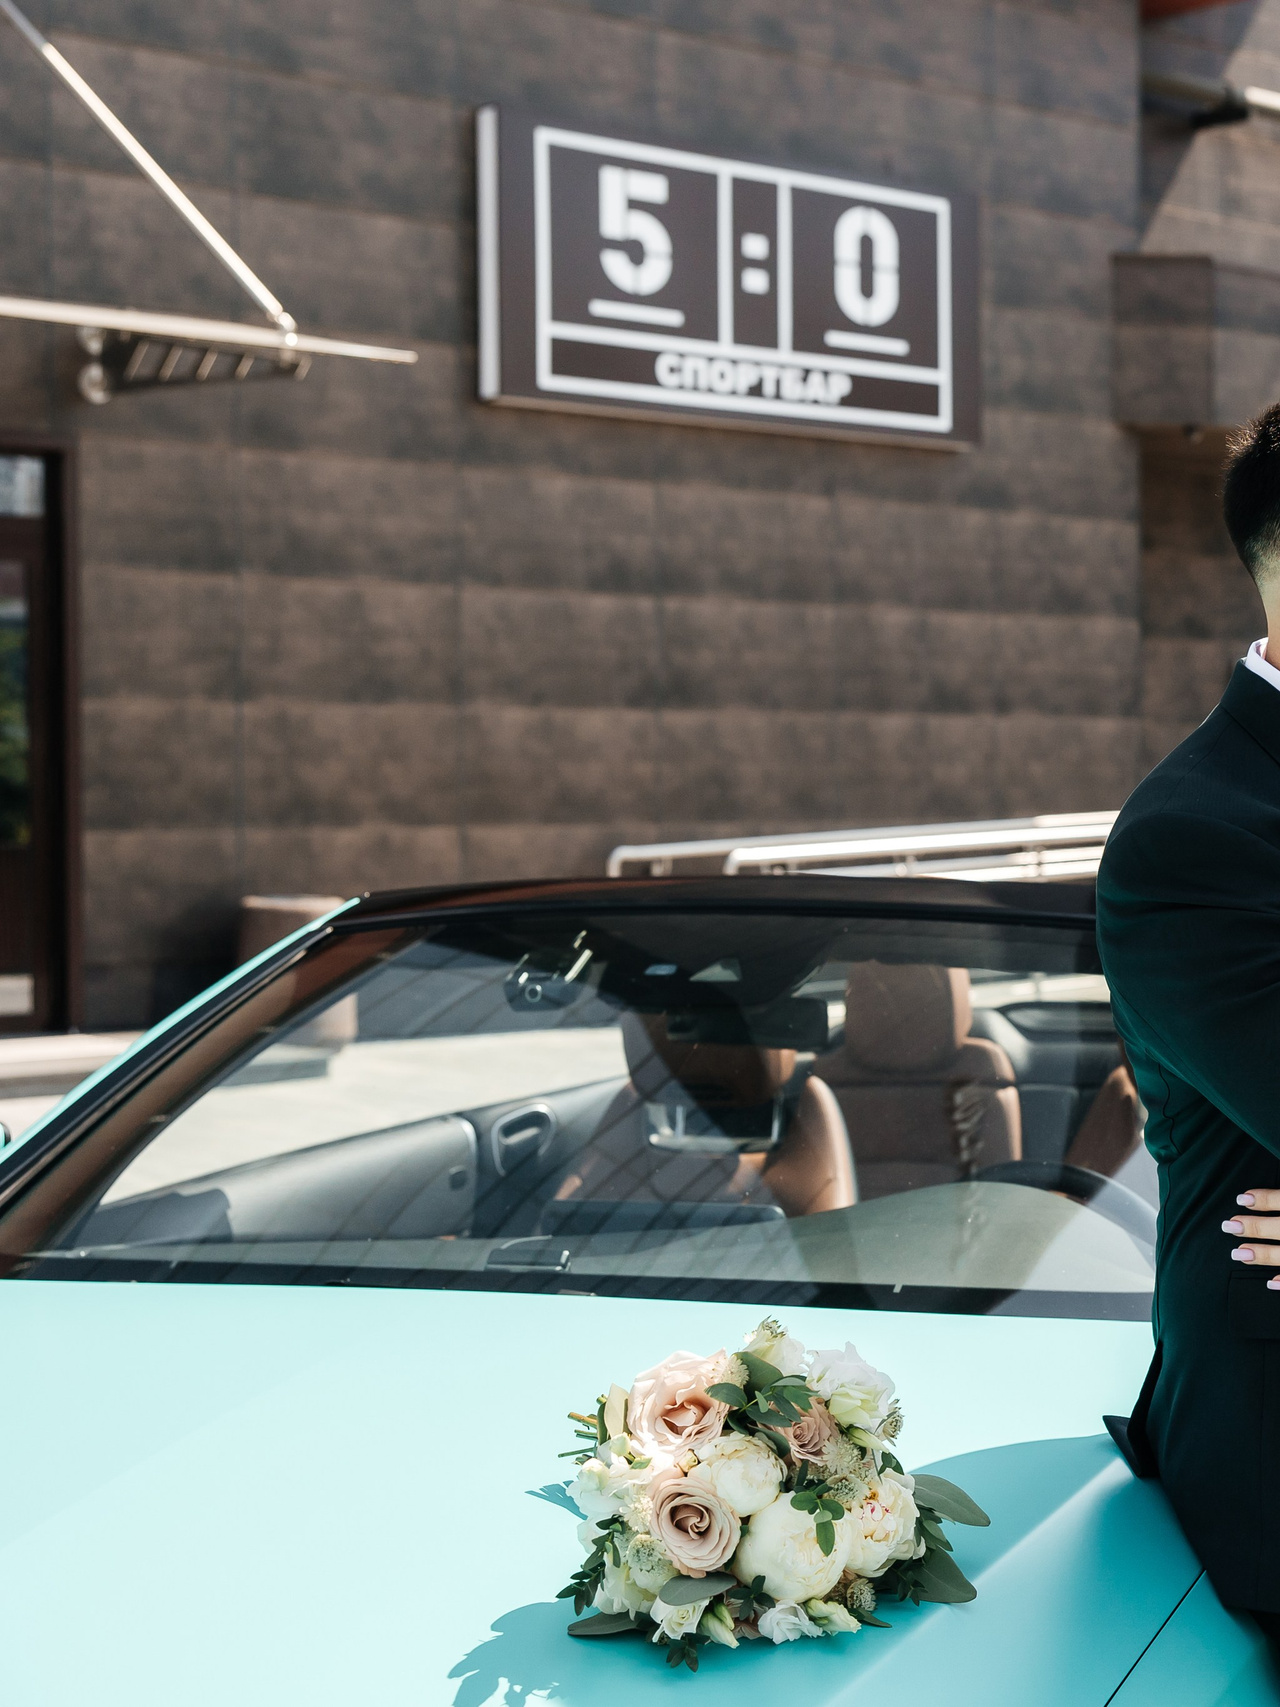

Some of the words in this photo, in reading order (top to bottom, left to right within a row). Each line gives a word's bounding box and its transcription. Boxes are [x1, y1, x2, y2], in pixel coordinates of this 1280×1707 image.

[600, 165, 673, 296] 5
[834, 206, 899, 327] 0
[655, 351, 853, 405] СПОРТБАР
